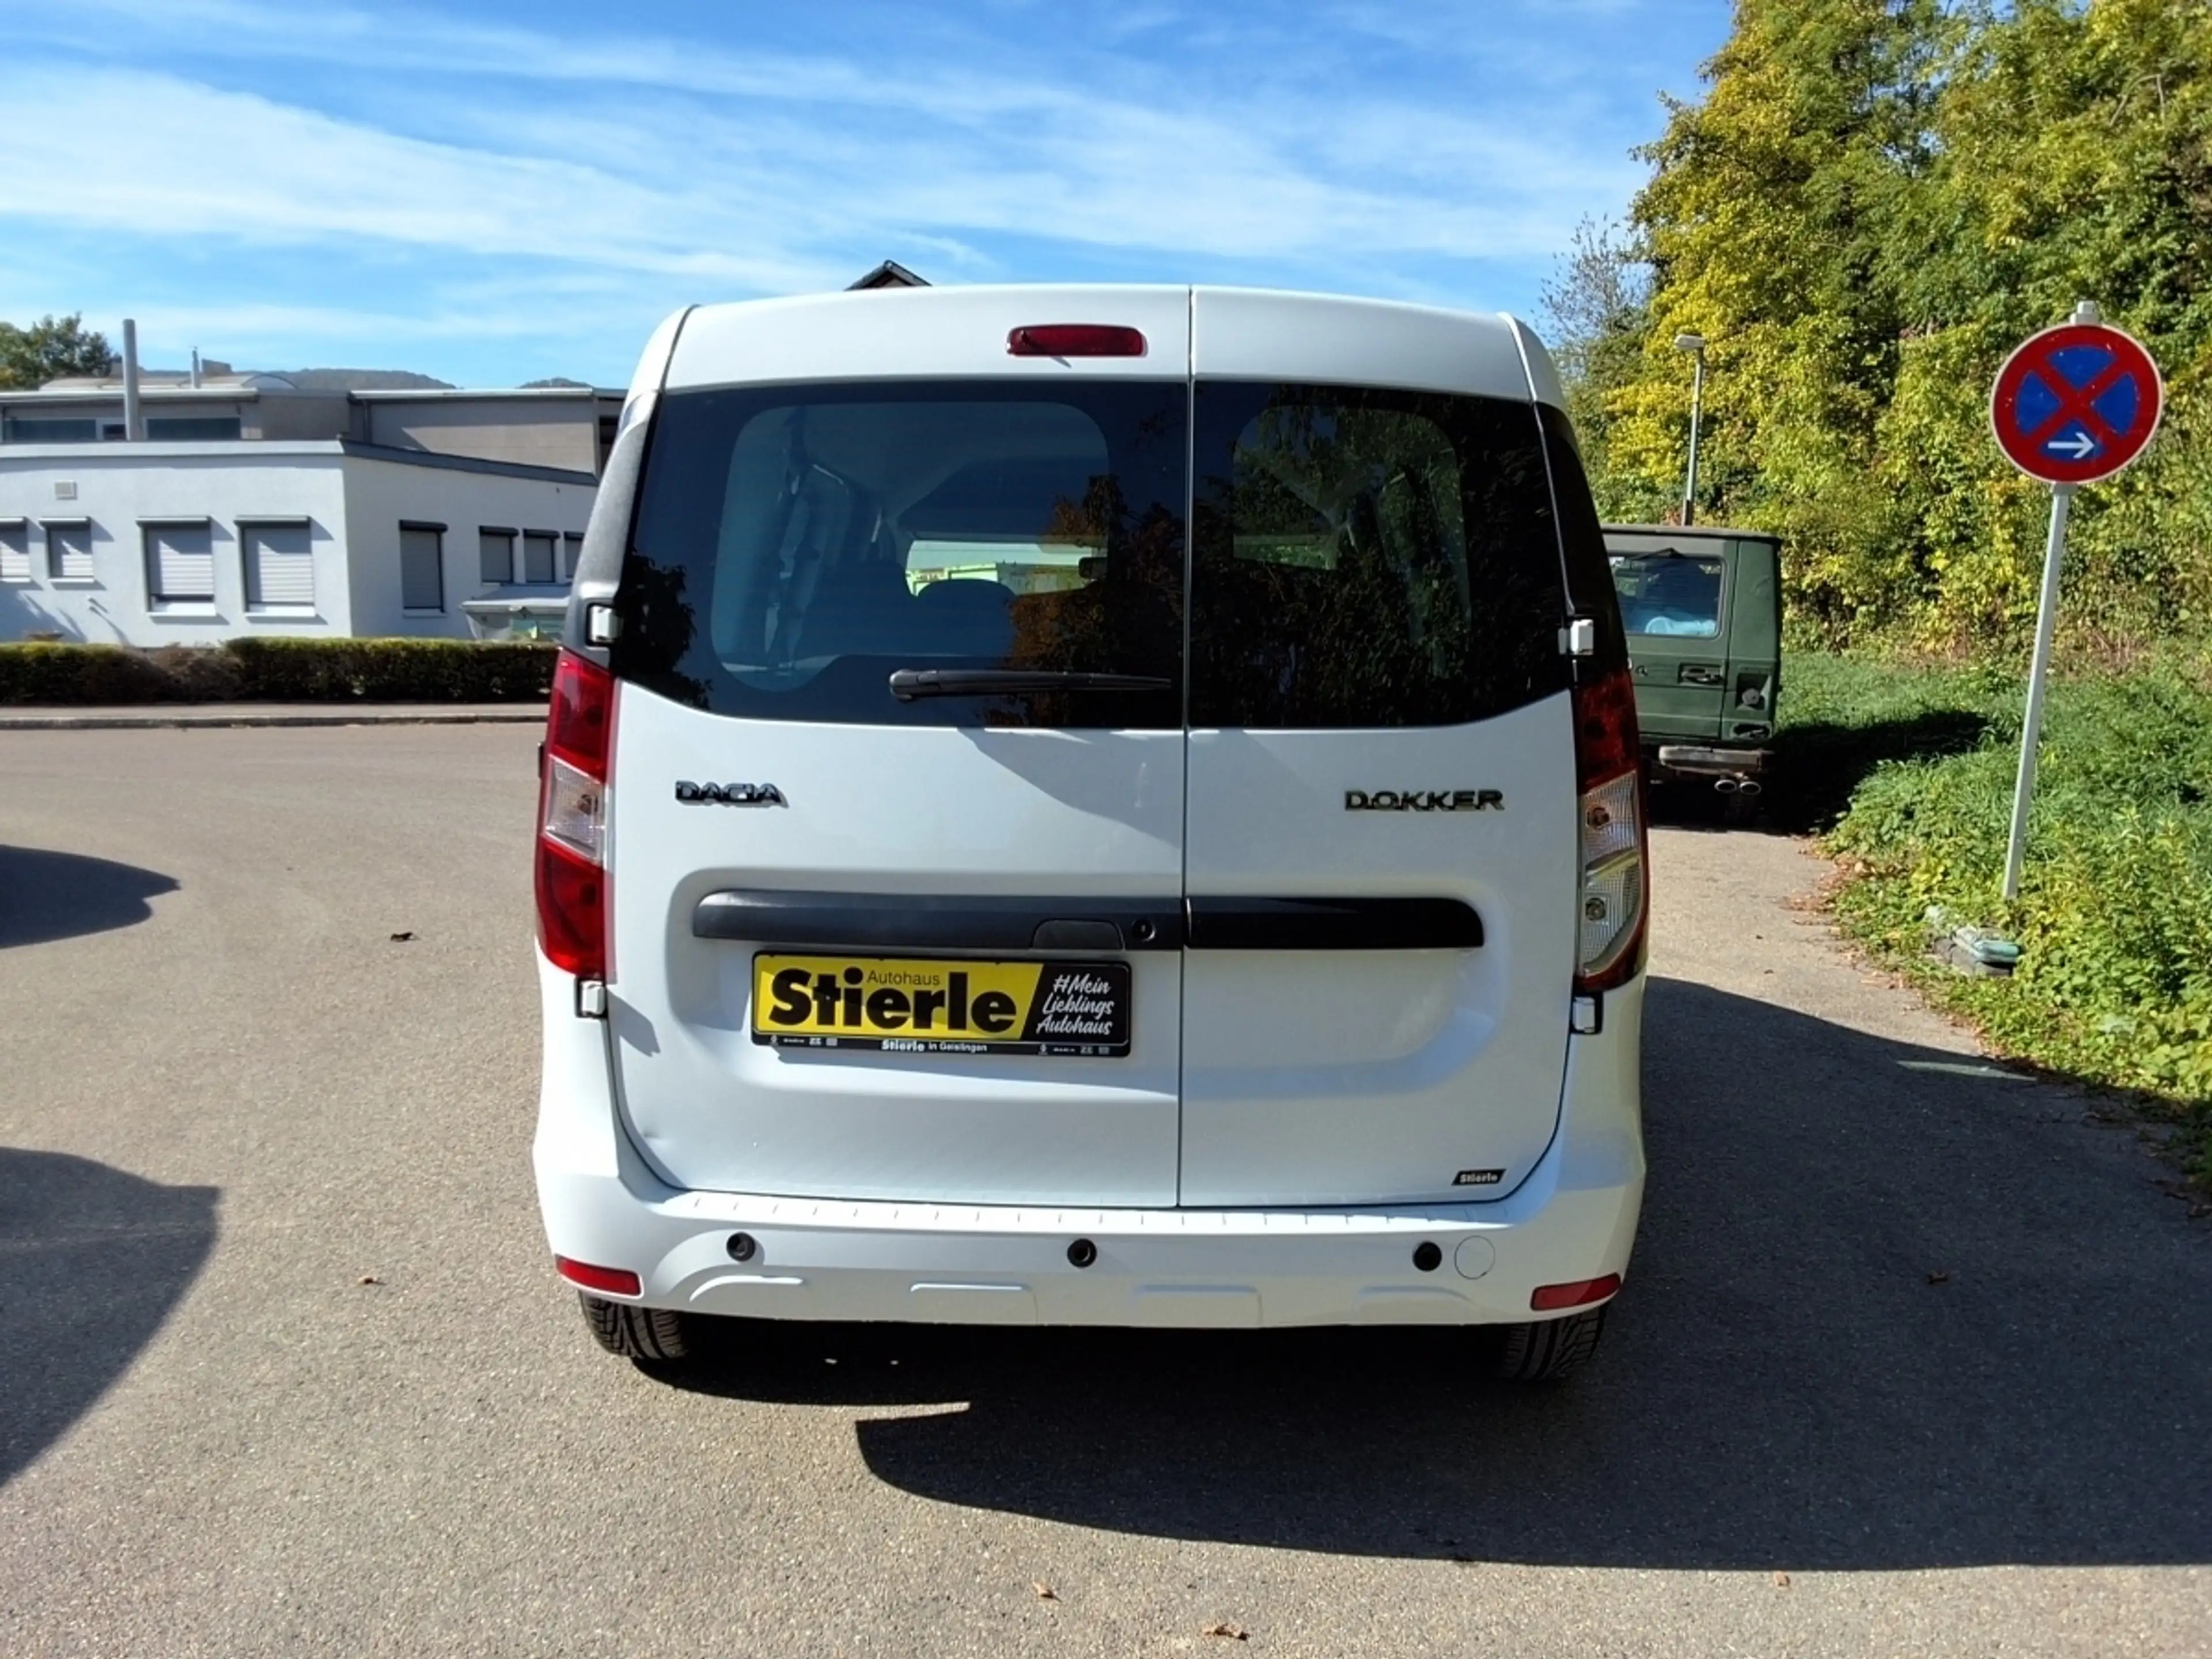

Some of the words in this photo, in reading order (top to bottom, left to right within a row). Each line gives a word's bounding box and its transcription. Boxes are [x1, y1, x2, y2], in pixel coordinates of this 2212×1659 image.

[675, 780, 784, 804] DACIA
[1344, 790, 1505, 811] DOKKER
[866, 969, 941, 986] Autohaus
[1052, 972, 1112, 995] #Mein
[768, 965, 1017, 1033] Stierle
[1041, 991, 1116, 1020] Lieblings
[1035, 1014, 1114, 1036] Autohaus
[881, 1039, 925, 1052] Stierle
